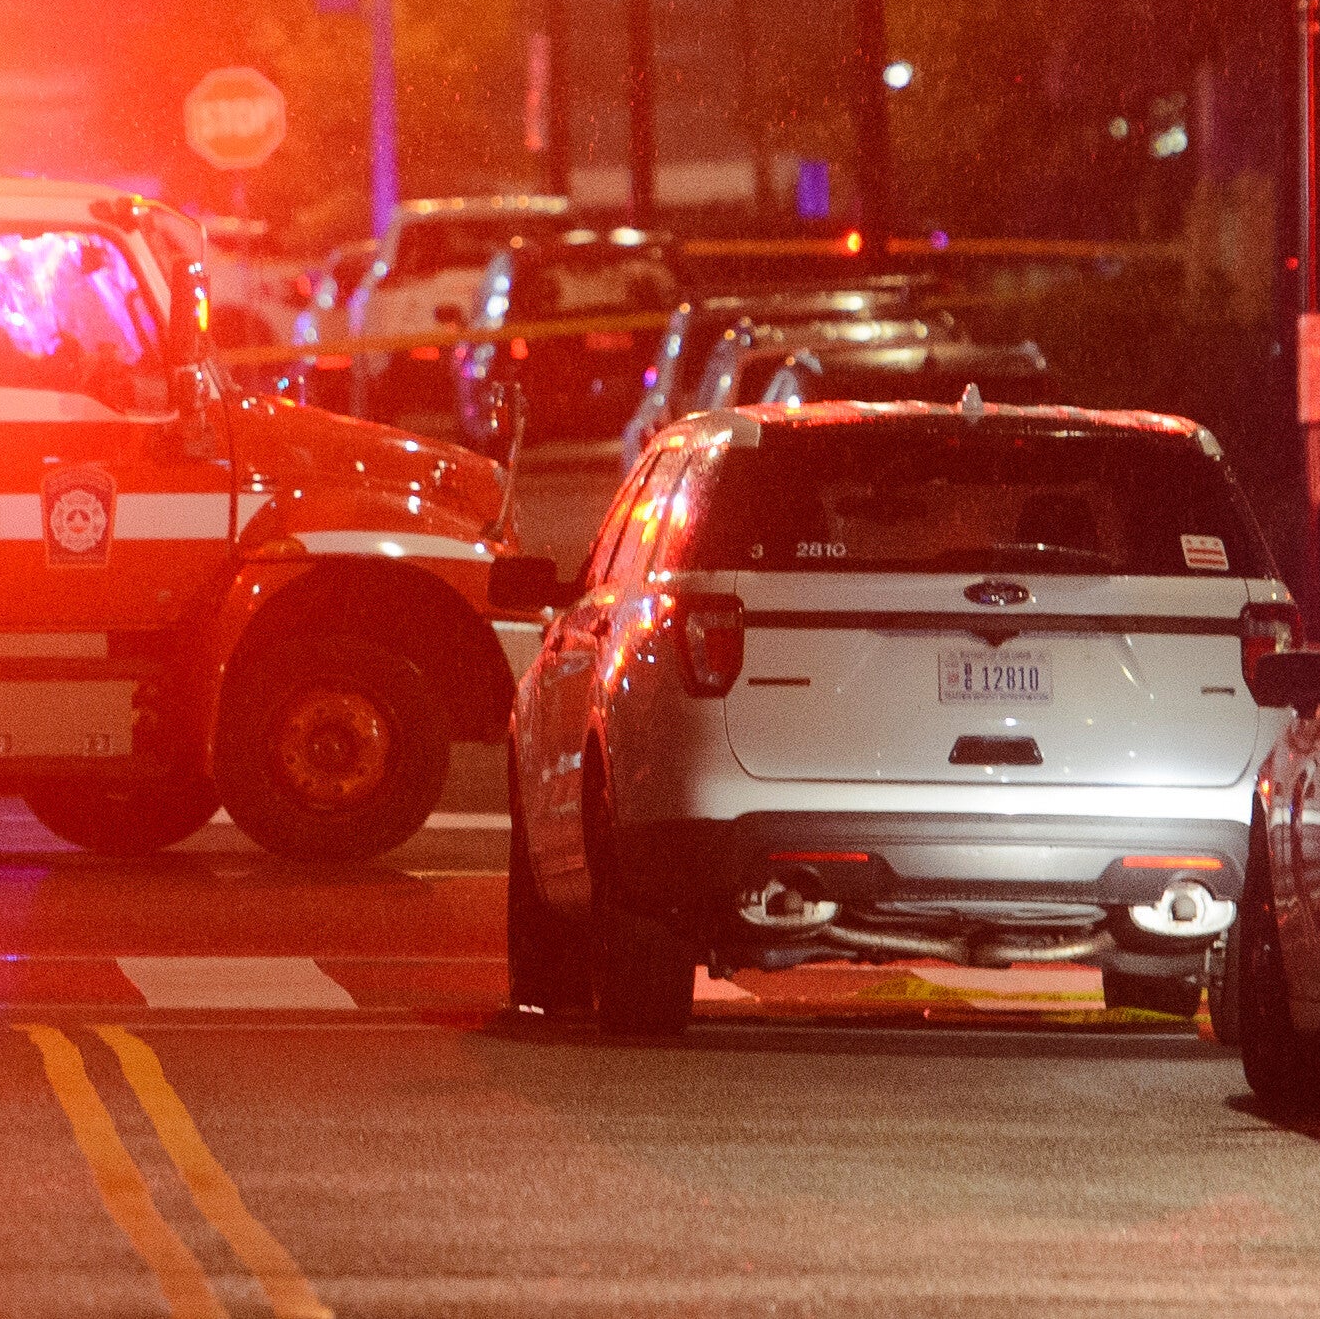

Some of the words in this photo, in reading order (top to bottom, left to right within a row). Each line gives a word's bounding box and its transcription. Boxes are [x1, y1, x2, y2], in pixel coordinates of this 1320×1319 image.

[751, 542, 764, 559] 3
[797, 542, 847, 558] 2810
[982, 666, 1039, 691] 12810
